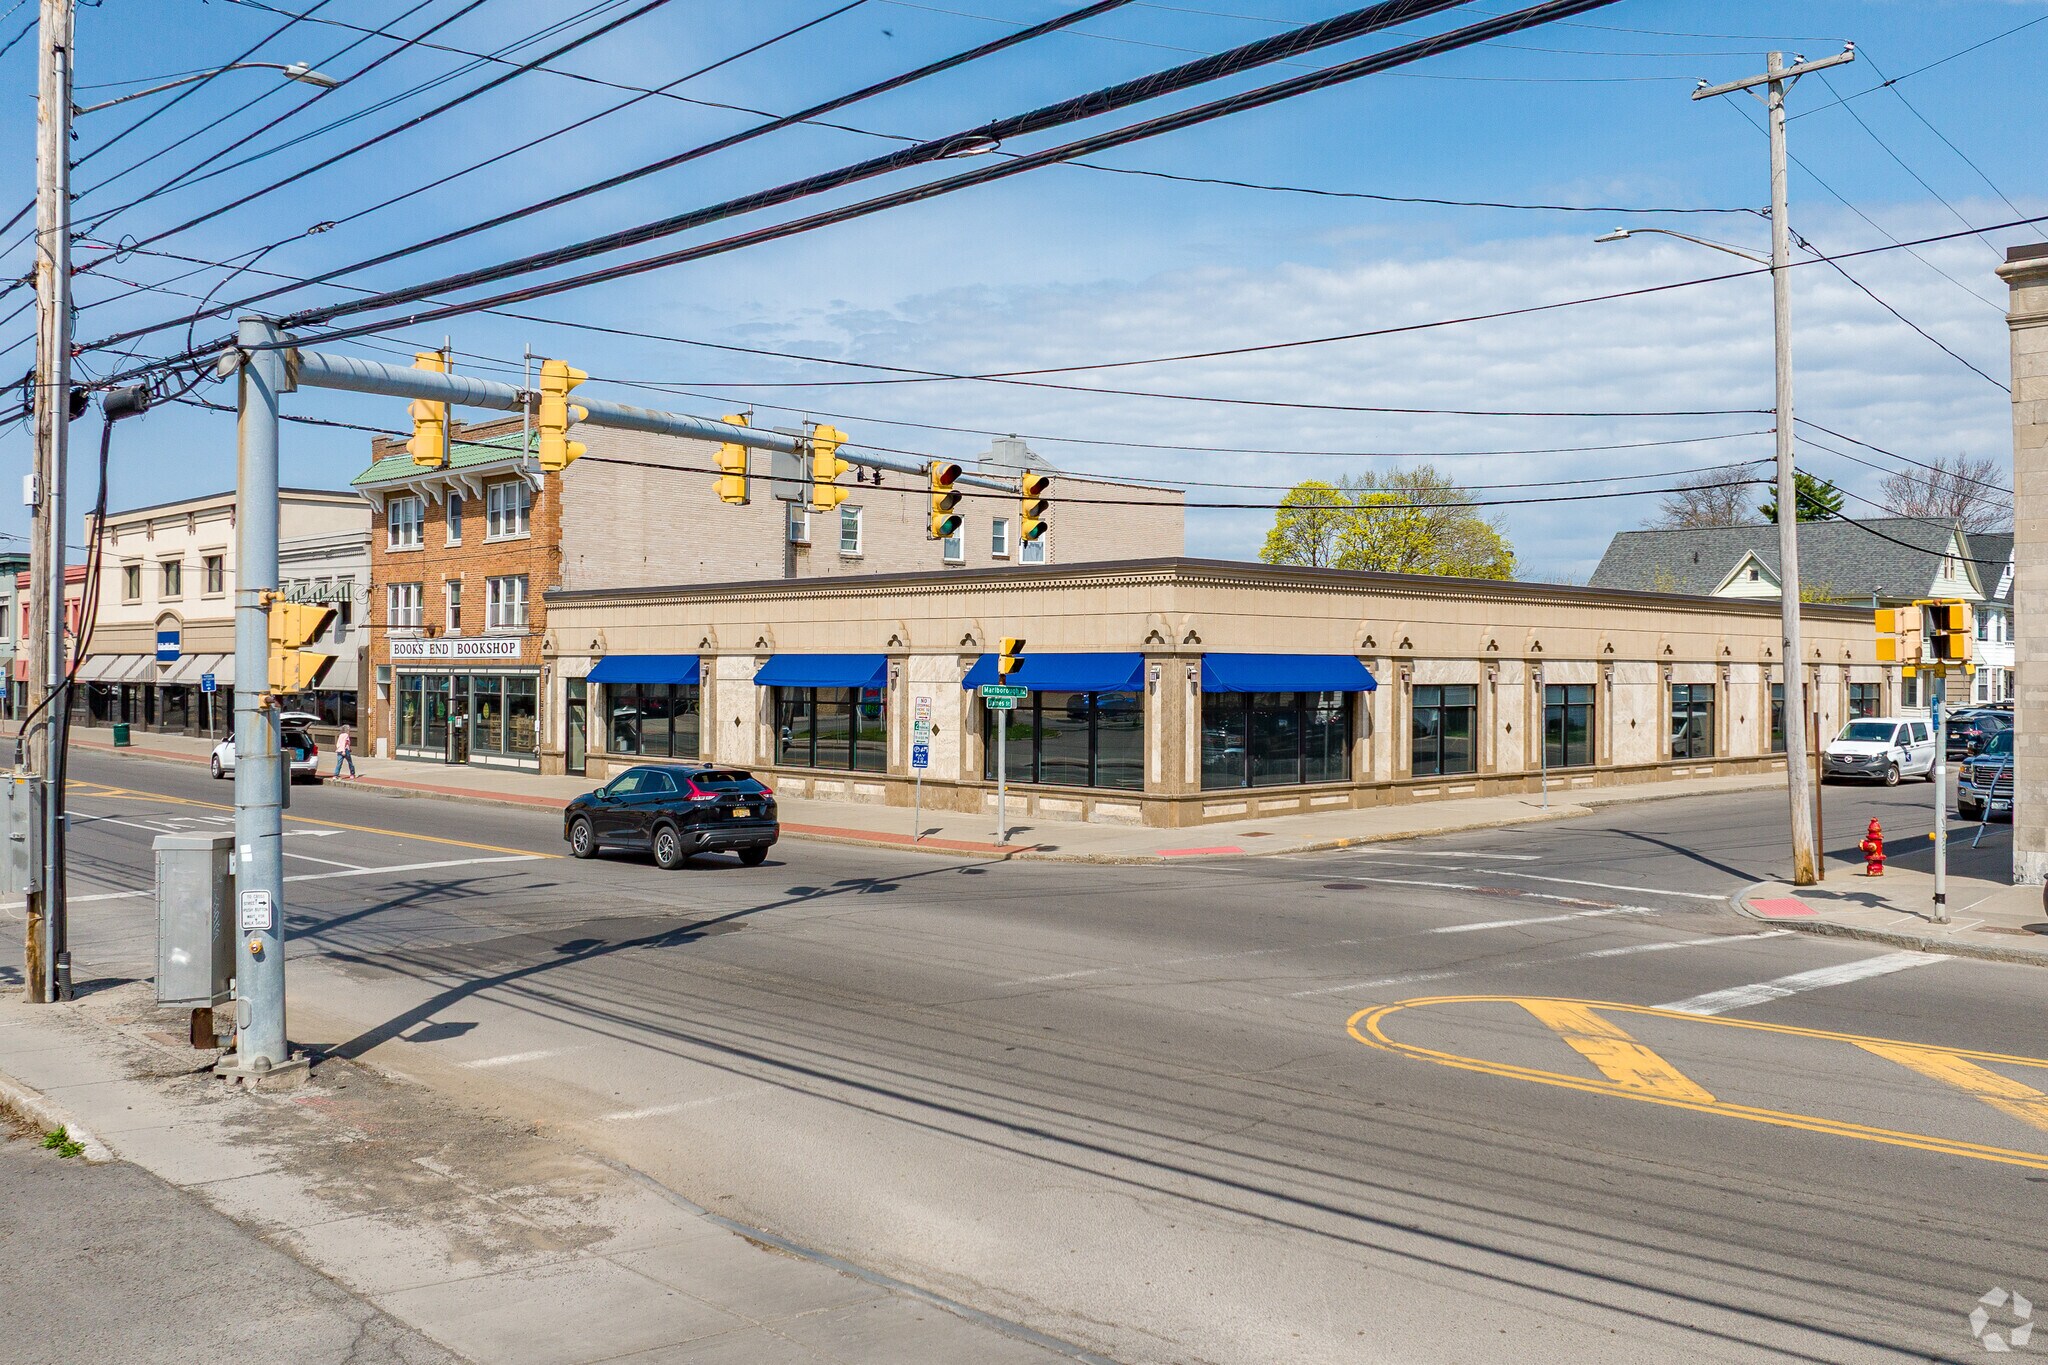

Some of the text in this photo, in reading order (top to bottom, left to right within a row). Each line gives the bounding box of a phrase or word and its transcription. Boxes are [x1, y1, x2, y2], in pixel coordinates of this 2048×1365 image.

[394, 642, 516, 655] BOOKS END BOOKSHOP
[984, 686, 1019, 695] Marlborough
